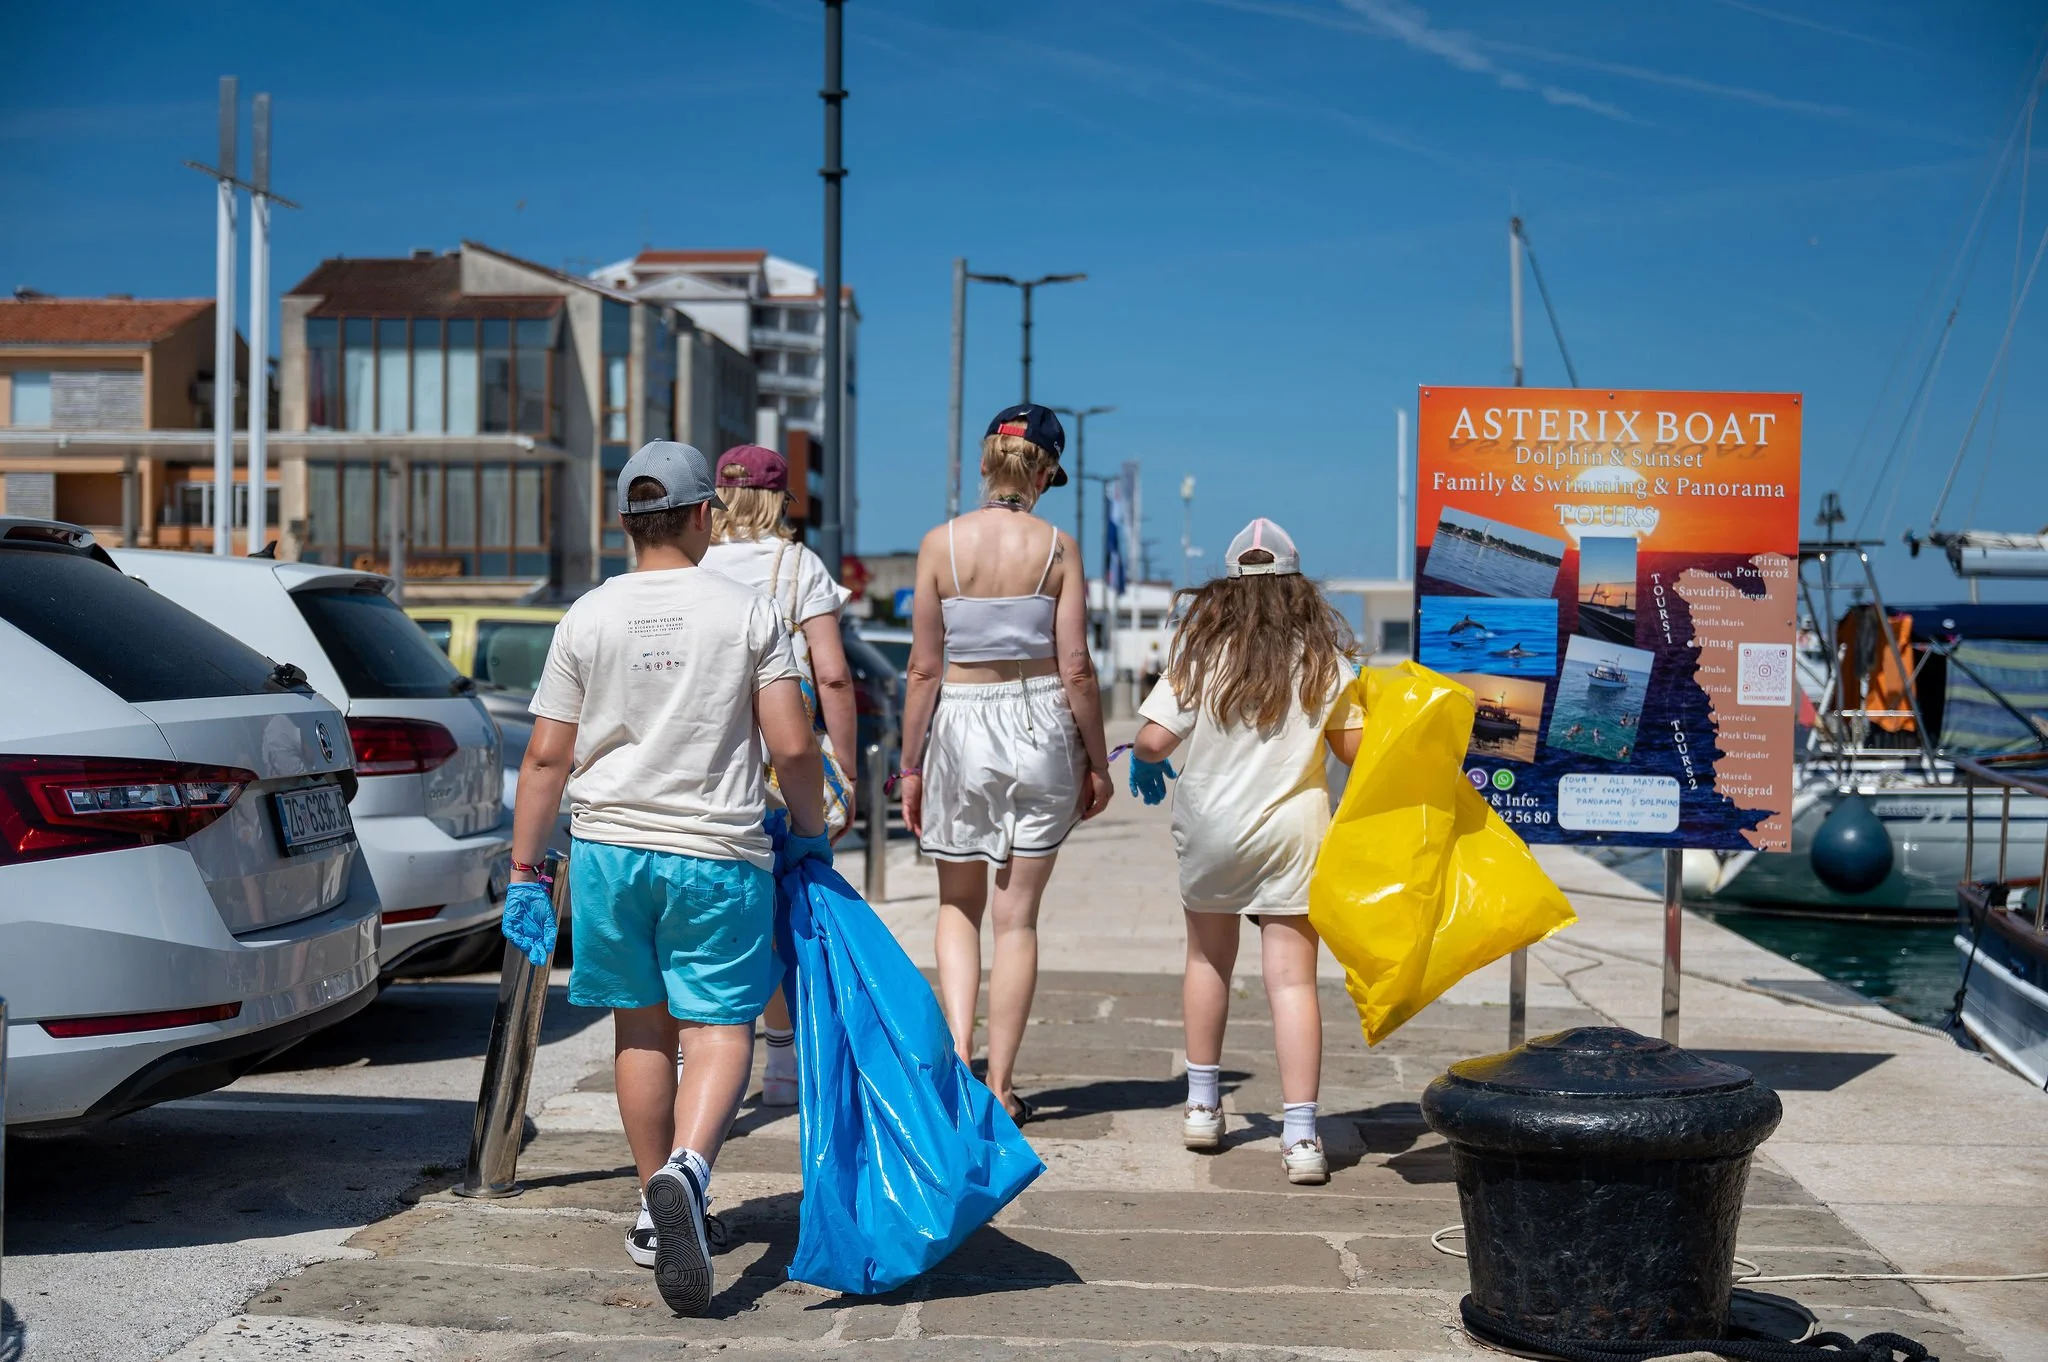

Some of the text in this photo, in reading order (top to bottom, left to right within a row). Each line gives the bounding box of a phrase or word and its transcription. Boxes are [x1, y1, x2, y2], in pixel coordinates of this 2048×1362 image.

[1449, 407, 1776, 446] ASTERIX BOAT
[1516, 446, 1703, 470] Dolphin & Sunset
[1433, 472, 1785, 500] Family & Swimming & Panorama
[1554, 503, 1656, 528] TOURS
[1755, 555, 1788, 567] Piran
[1719, 571, 1733, 579] vrh
[1737, 566, 1789, 578] Portorož
[1678, 586, 1736, 599] Savudrija
[1696, 618, 1719, 626] Stella
[1699, 637, 1734, 649] Umag
[1722, 732, 1767, 741] Park Umag
[1729, 751, 1770, 760] Karigador
[1722, 773, 1752, 781] Mareda
[1720, 785, 1773, 797] Novigrad
[1491, 793, 1502, 806] &
[1505, 792, 1539, 807] Info:
[284, 798, 305, 836] ZG
[1515, 811, 1531, 823] 56
[1534, 811, 1551, 824] 80
